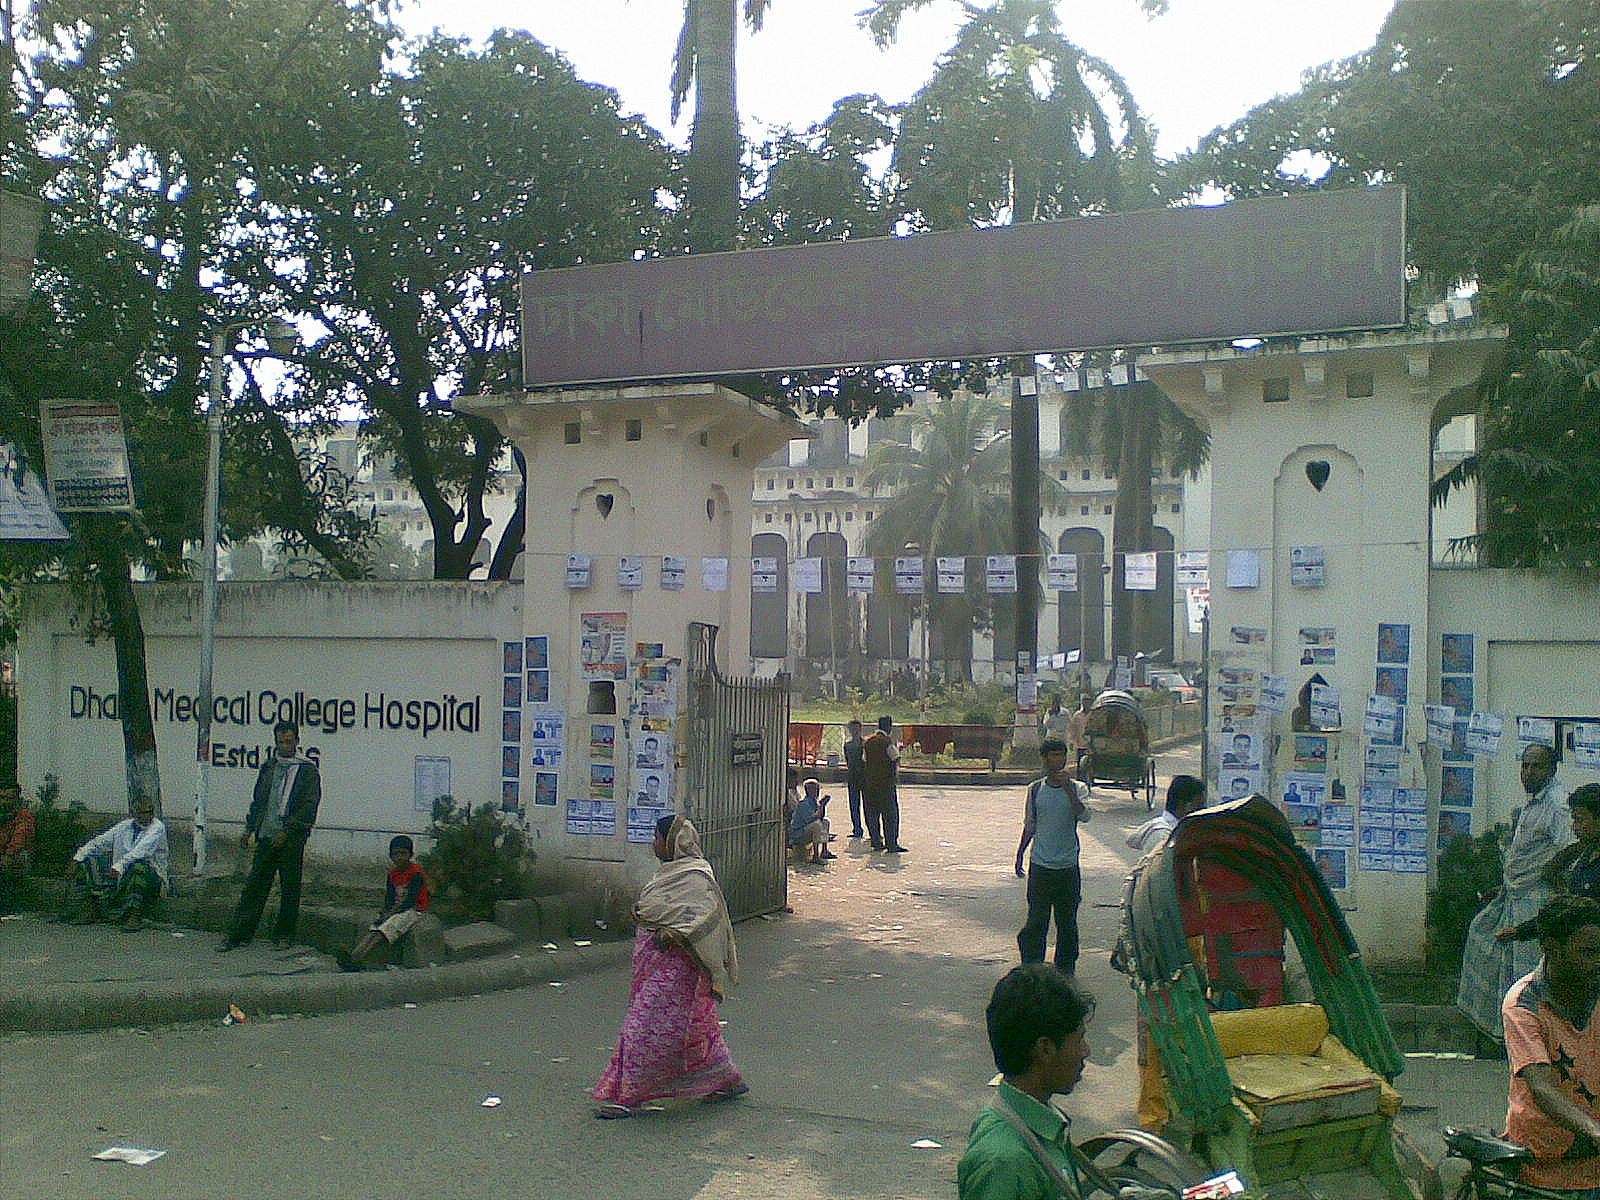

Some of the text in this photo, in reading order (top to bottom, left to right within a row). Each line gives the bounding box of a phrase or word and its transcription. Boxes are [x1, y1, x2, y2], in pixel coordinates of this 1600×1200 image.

[531, 284, 632, 342] ঢাকা
[70, 686, 480, 738] Dha Mecal College Hospital
[212, 743, 260, 769] Estd
